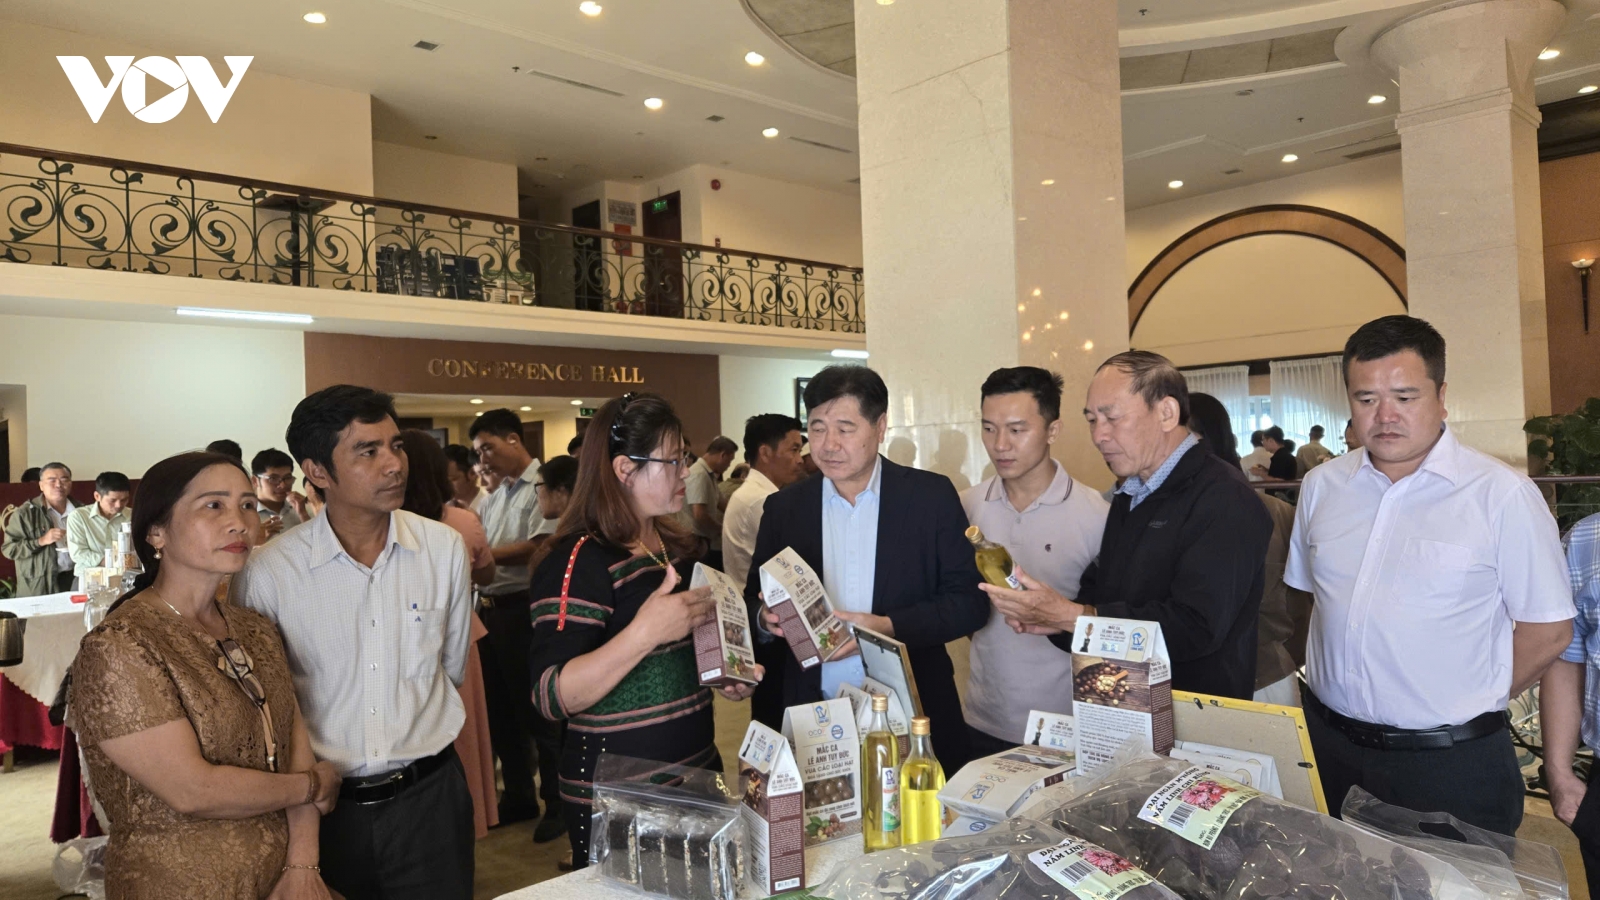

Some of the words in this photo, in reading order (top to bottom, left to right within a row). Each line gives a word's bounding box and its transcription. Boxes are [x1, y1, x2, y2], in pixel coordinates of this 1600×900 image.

[428, 357, 582, 381] CONFERENCE
[591, 365, 644, 383] HALL
[831, 744, 838, 753] CA
[816, 754, 828, 764] ANH
[828, 752, 839, 762] TUY
[805, 766, 817, 774] VUA
[1160, 781, 1178, 797] NGÀN
[1167, 788, 1182, 802] LINH
[1181, 779, 1194, 791] CHI
[1044, 853, 1065, 868] NẤM
